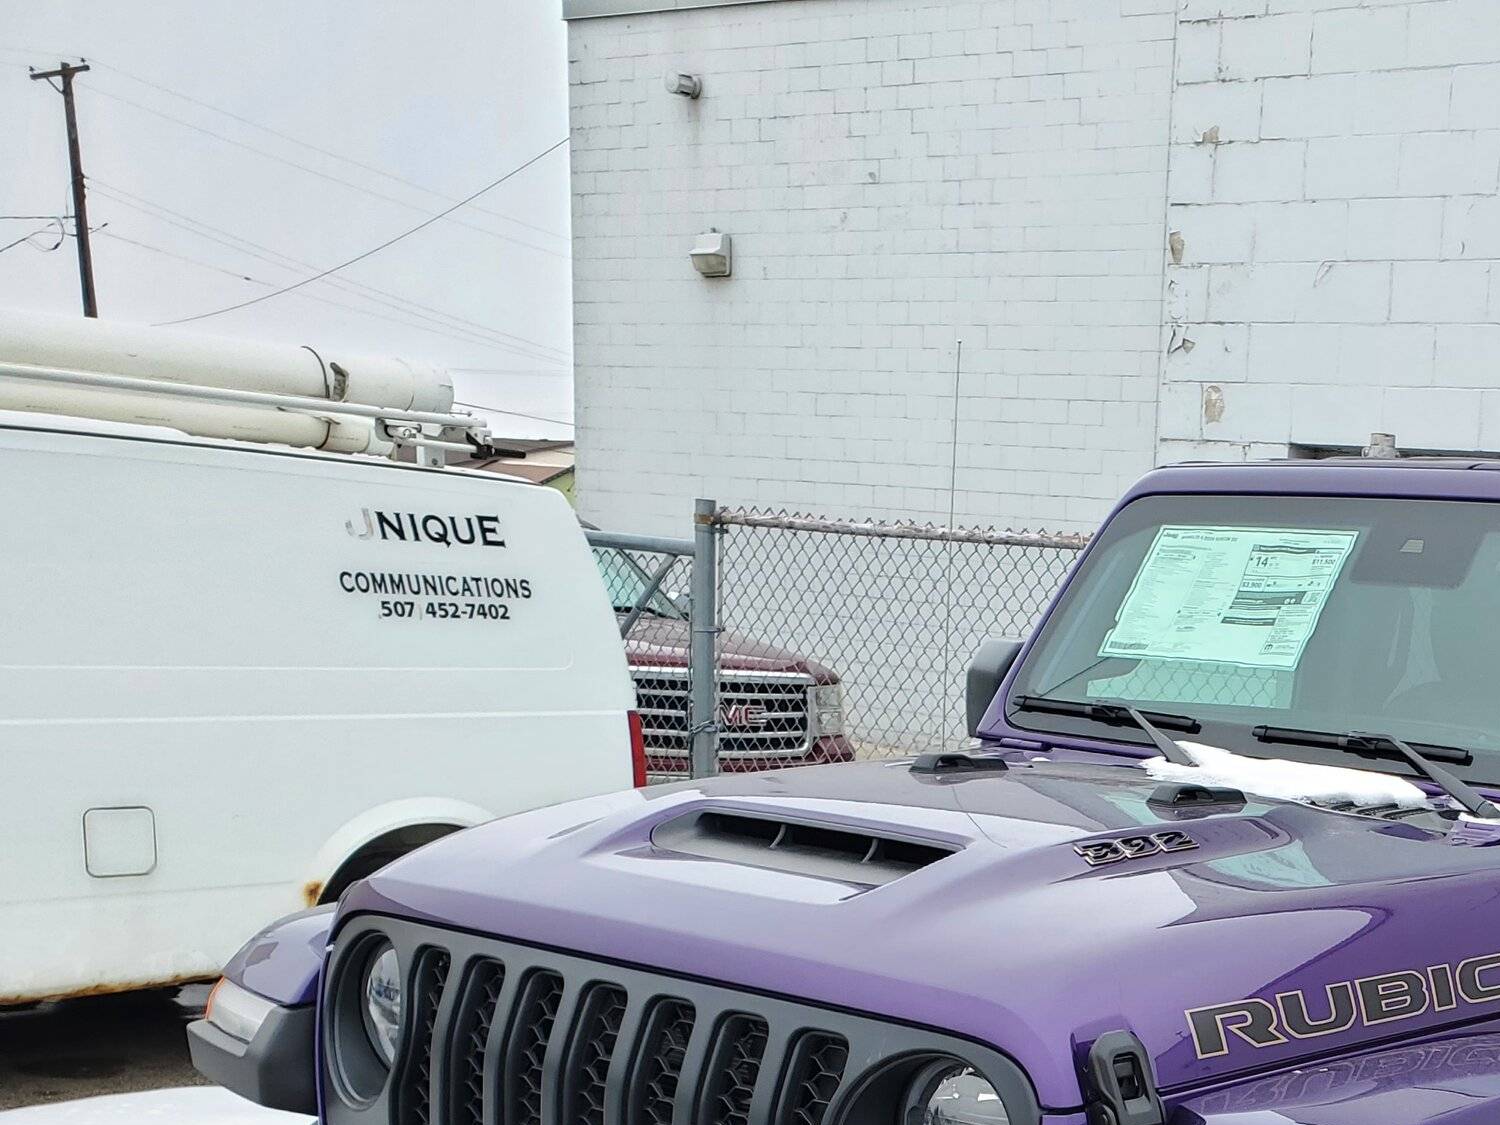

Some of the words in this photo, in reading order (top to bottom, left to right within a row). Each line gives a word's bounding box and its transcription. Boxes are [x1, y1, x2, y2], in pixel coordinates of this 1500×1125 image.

[339, 570, 532, 599] COMMUNICATIONS
[380, 601, 415, 618] 507
[425, 602, 510, 620] 452-7402
[717, 704, 767, 727] MC
[1073, 830, 1200, 866] 392
